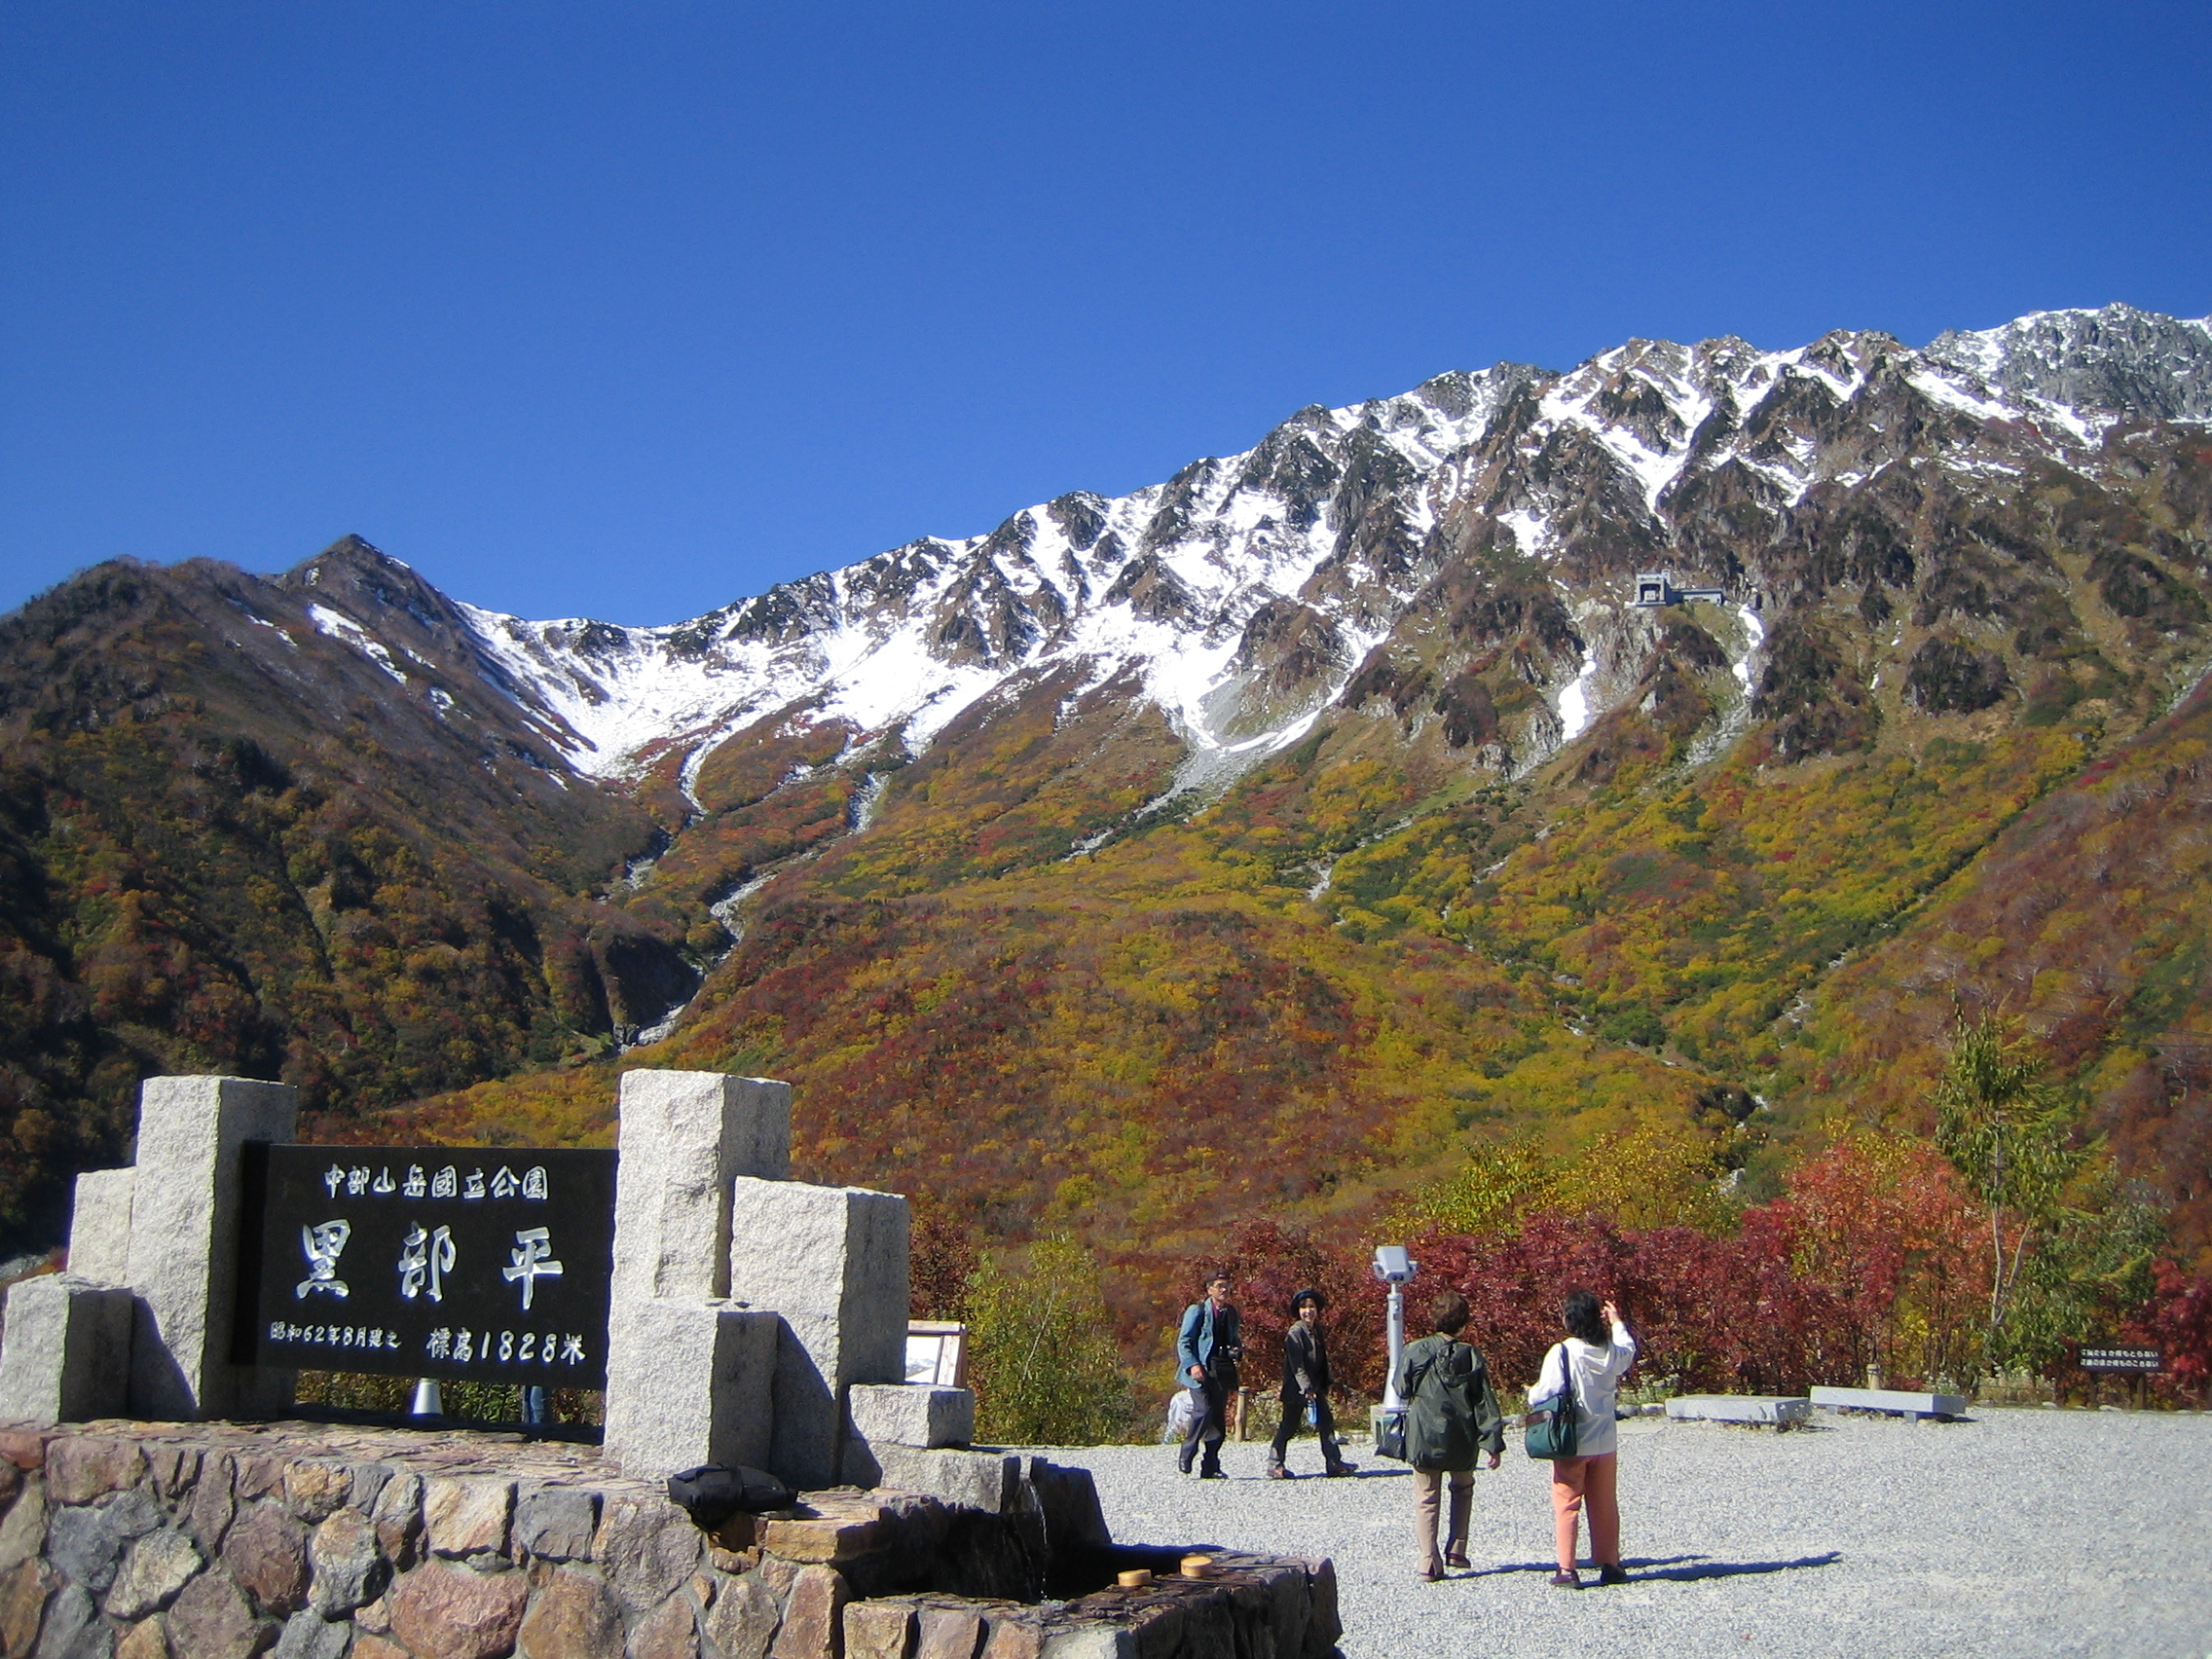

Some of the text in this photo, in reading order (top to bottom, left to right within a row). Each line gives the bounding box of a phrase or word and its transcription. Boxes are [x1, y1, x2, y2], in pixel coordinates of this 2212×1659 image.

[296, 1219, 564, 1310] 黒部平
[425, 1327, 586, 1365] 標高1828米
